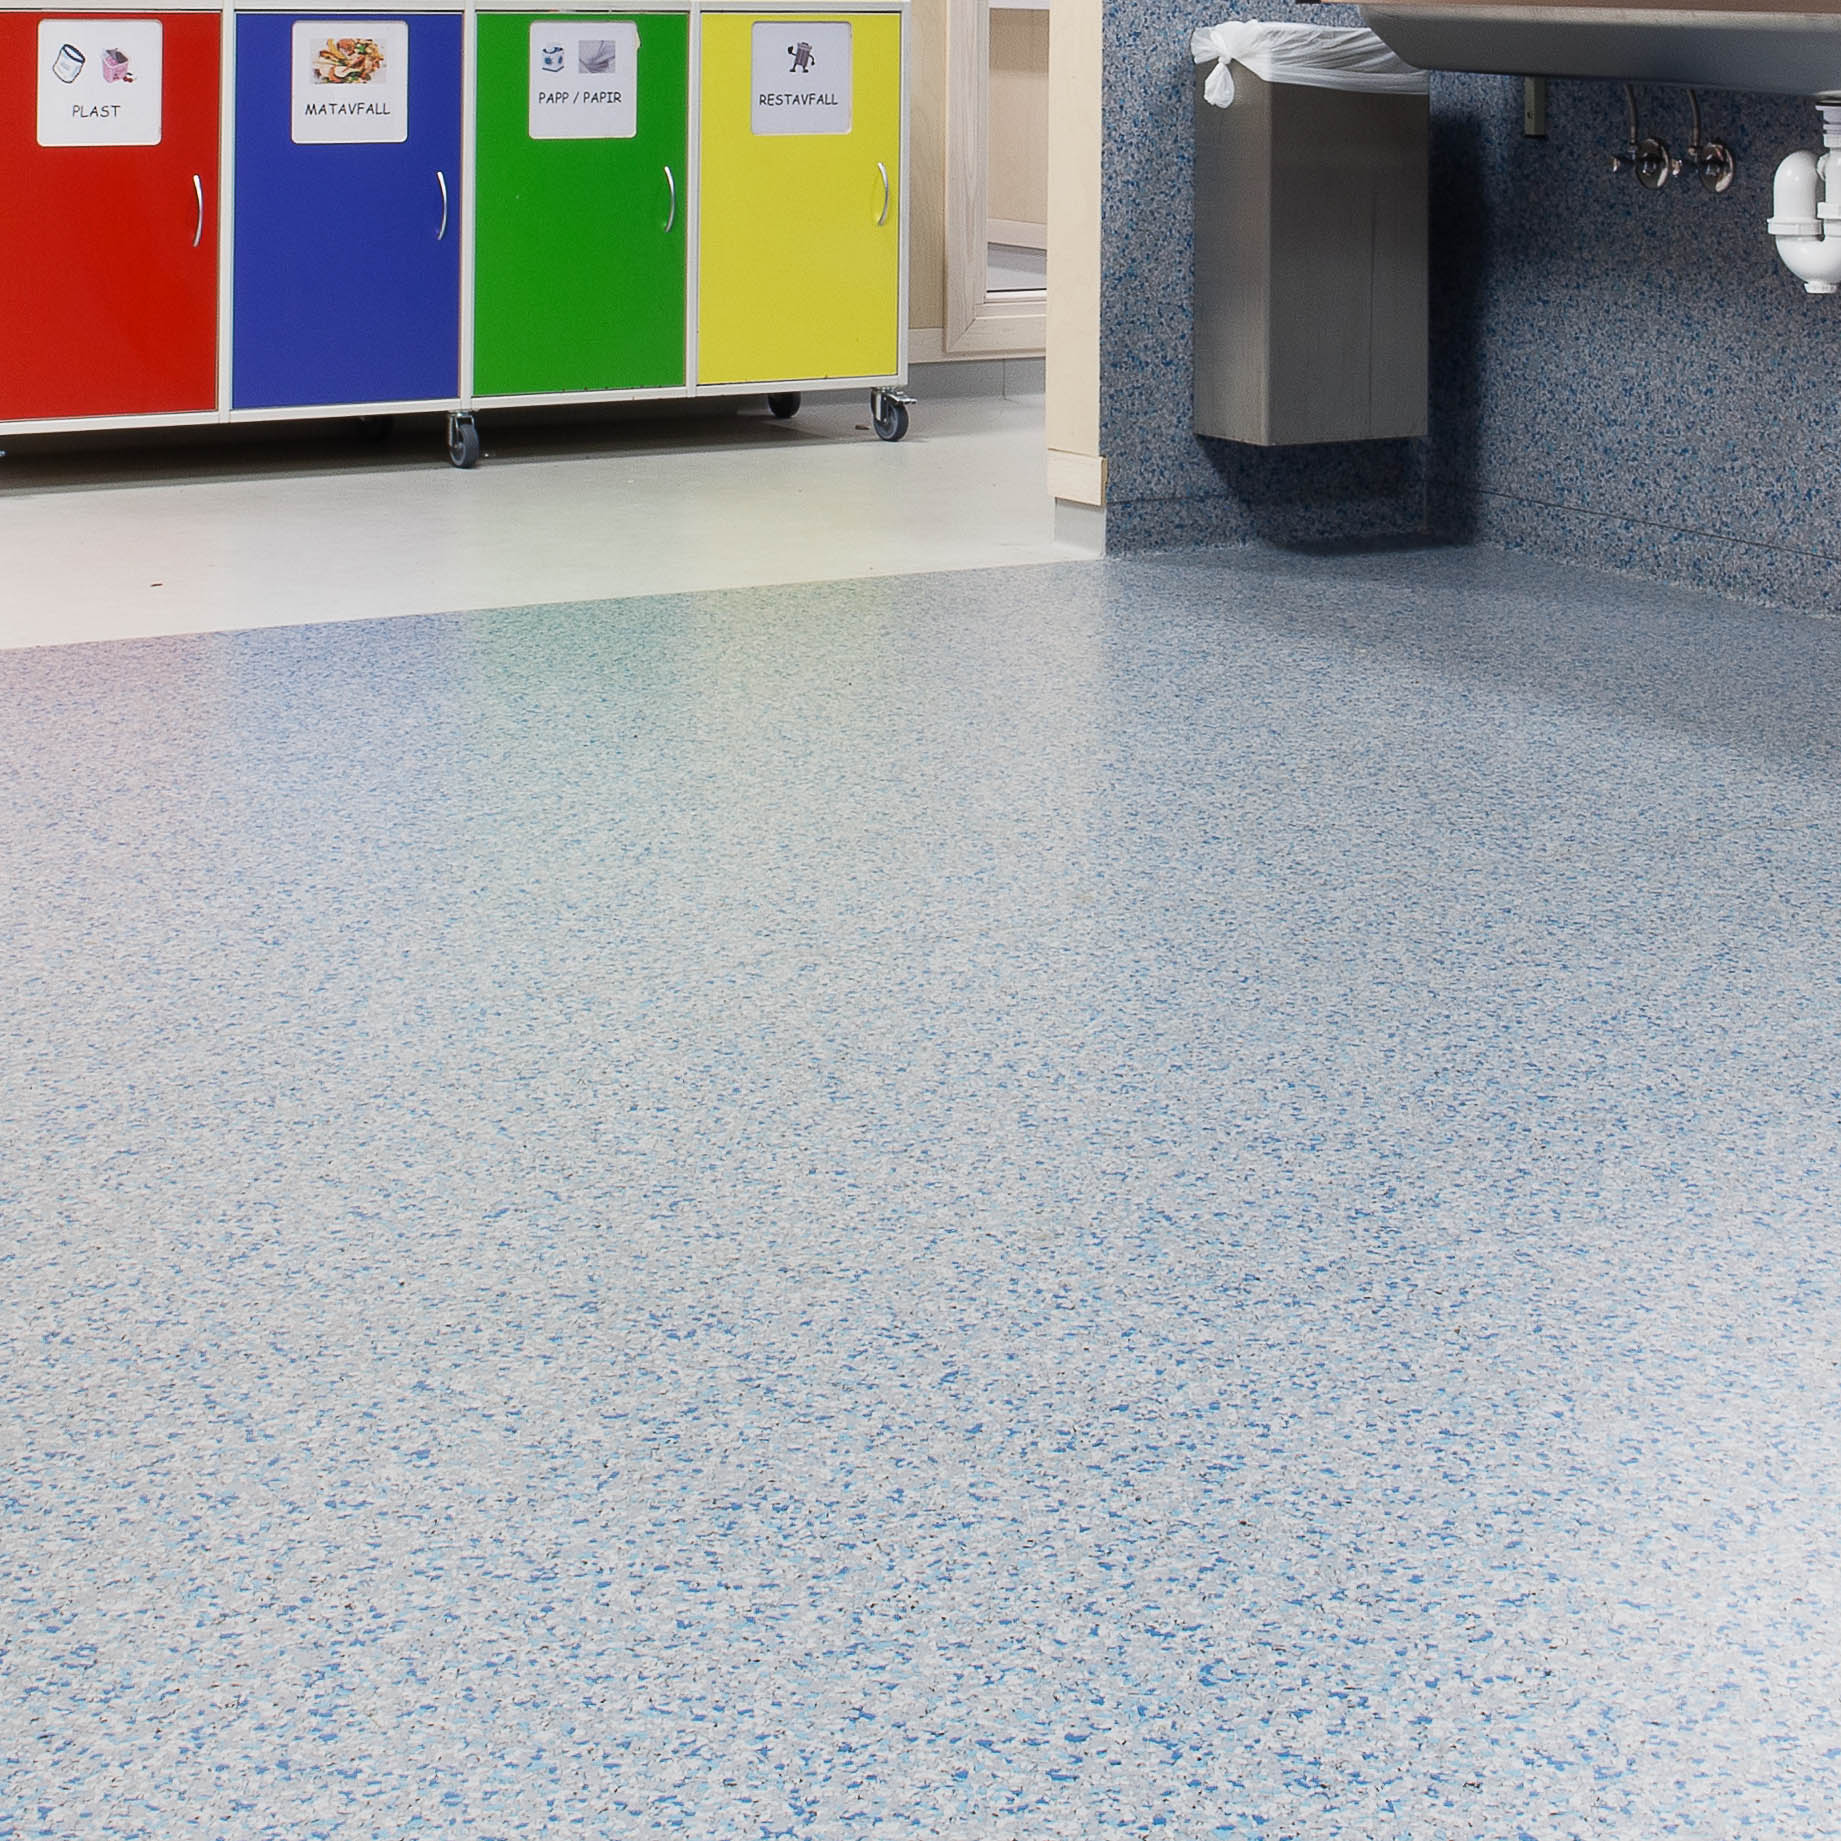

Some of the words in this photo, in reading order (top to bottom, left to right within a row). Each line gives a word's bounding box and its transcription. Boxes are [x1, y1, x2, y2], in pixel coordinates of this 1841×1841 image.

[538, 91, 569, 104] PAPP
[583, 91, 622, 104] PAPIR
[759, 93, 838, 106] RESTAVFALL
[72, 104, 121, 118] PLAST
[305, 102, 391, 116] MATAVFALL
